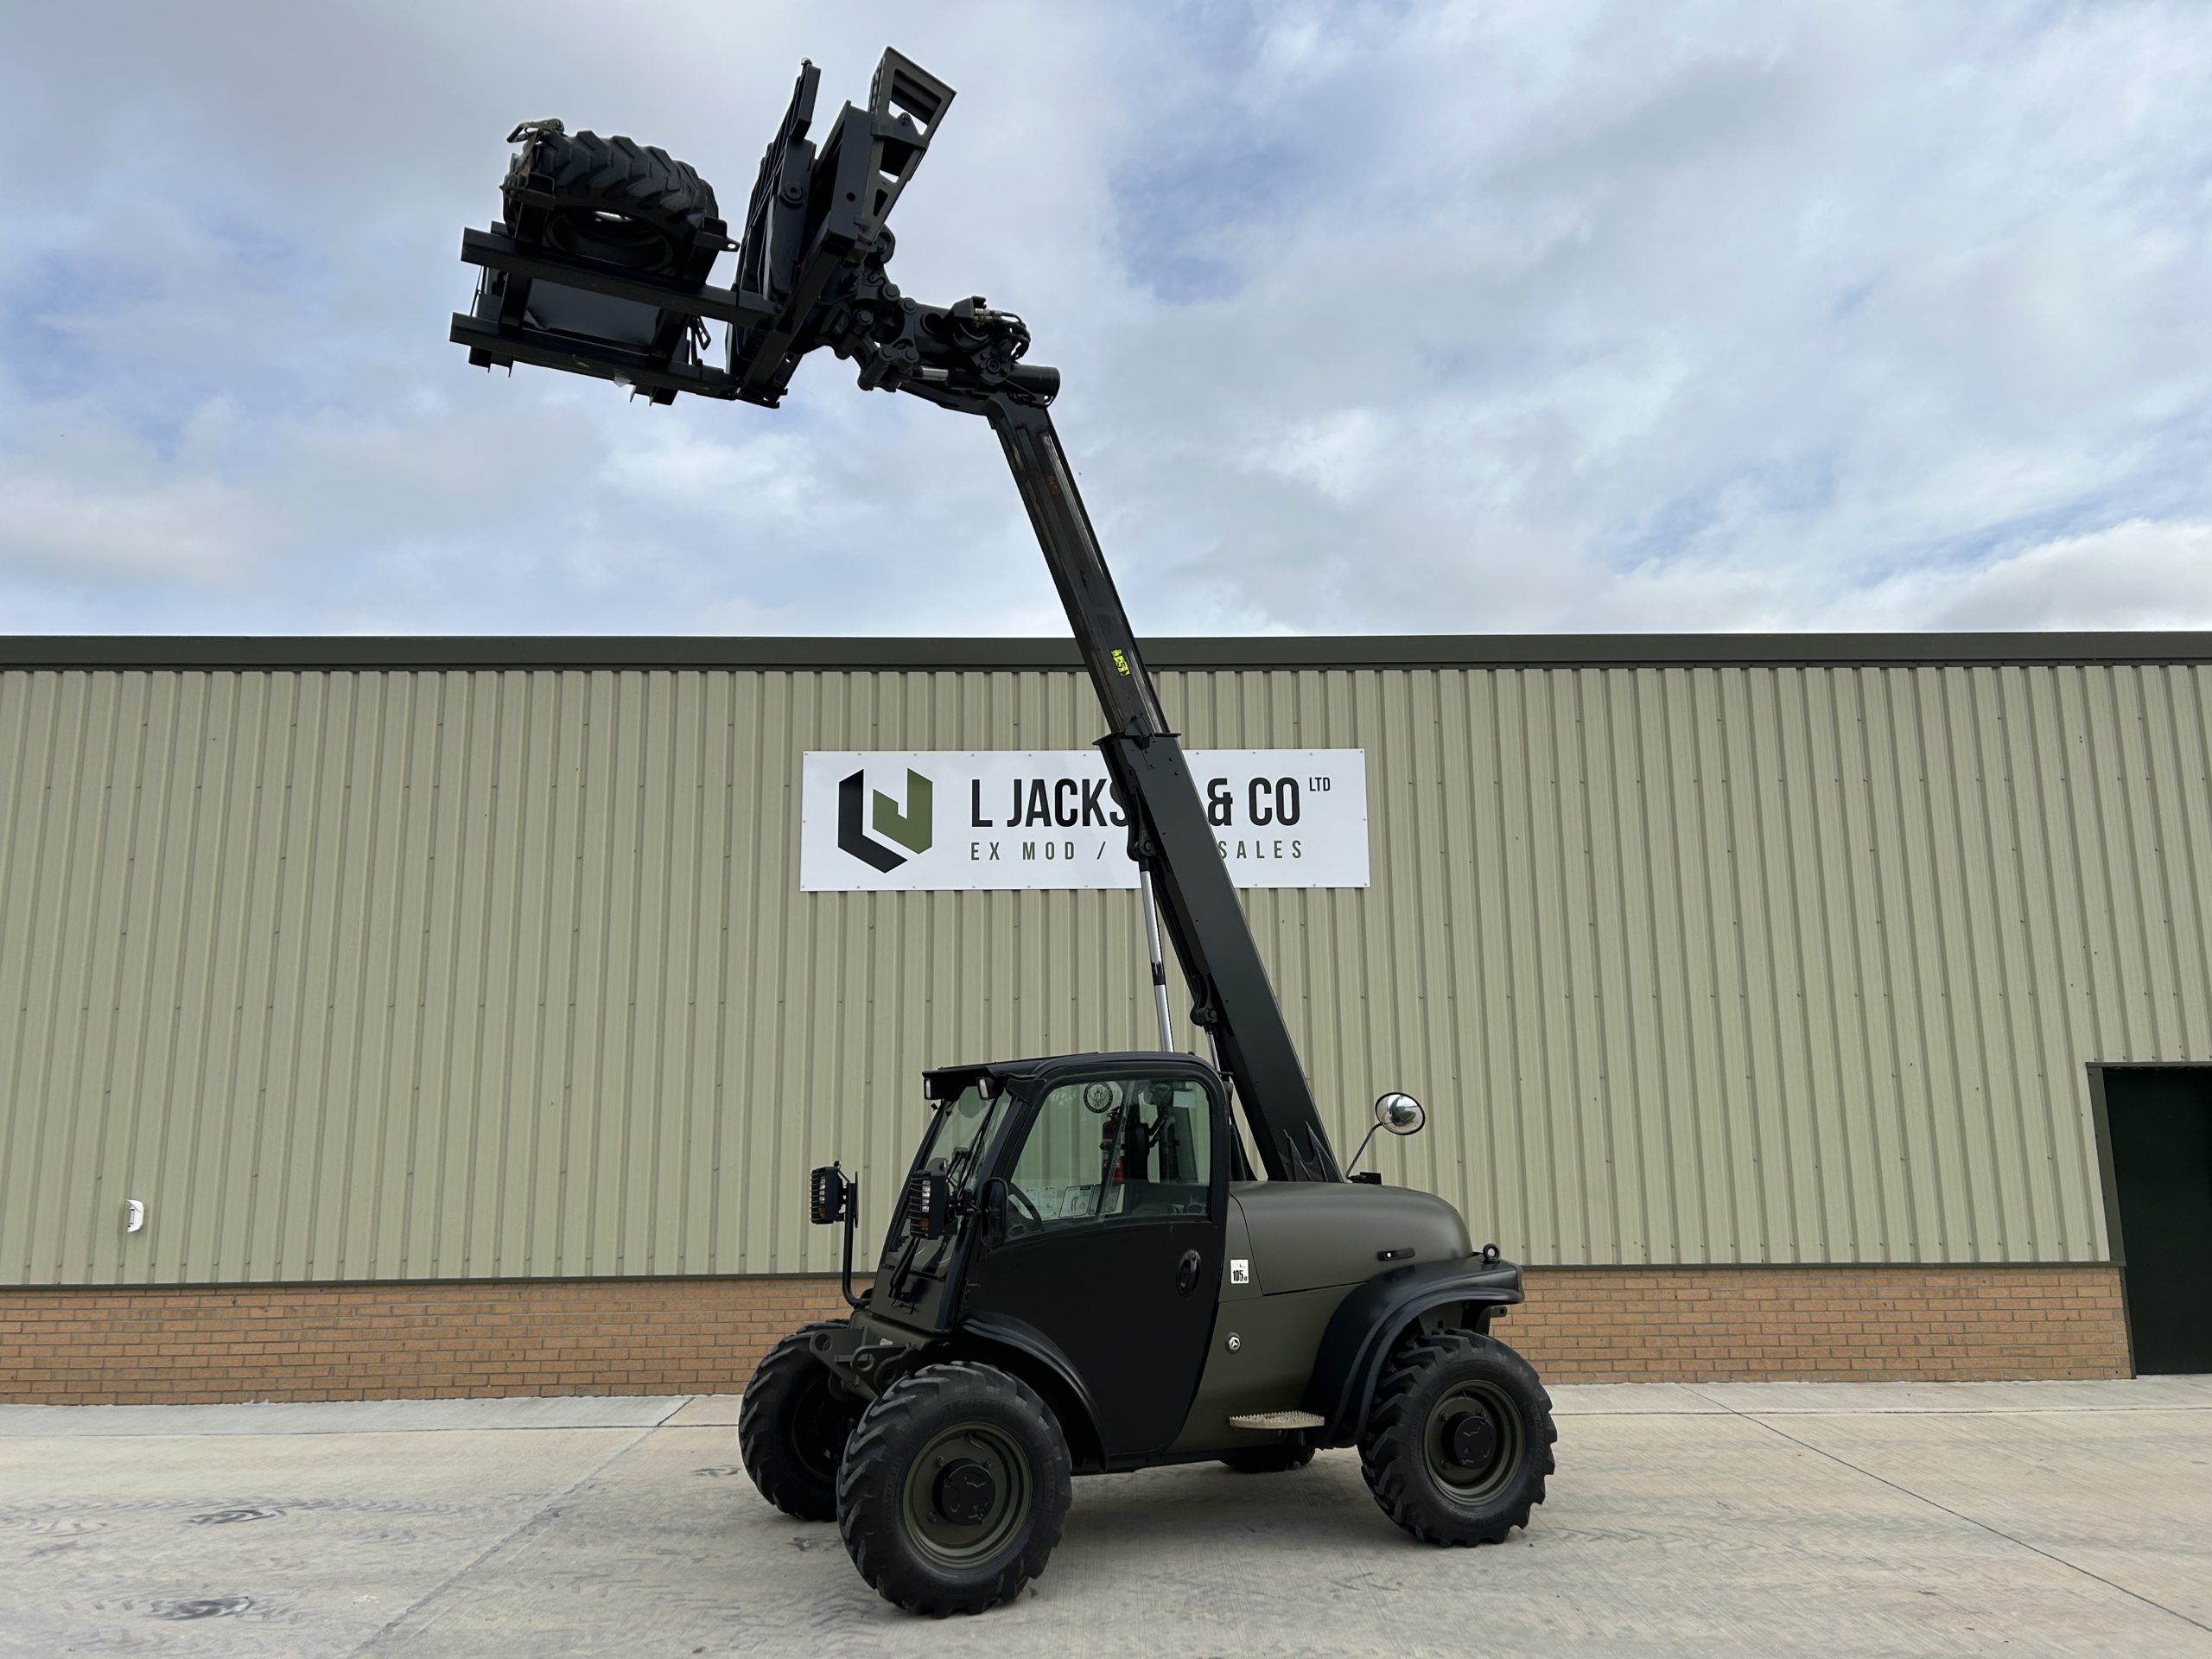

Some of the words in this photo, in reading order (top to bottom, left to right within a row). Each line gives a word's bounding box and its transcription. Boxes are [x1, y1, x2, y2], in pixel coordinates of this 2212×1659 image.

[971, 779, 994, 828] L
[1006, 779, 1129, 828] JACKS
[1207, 778, 1234, 827] &
[1248, 777, 1300, 827] CO
[1308, 777, 1331, 792] LTD
[970, 842, 1001, 861] EX
[1022, 841, 1075, 861] MOD
[1217, 840, 1301, 859] SALES
